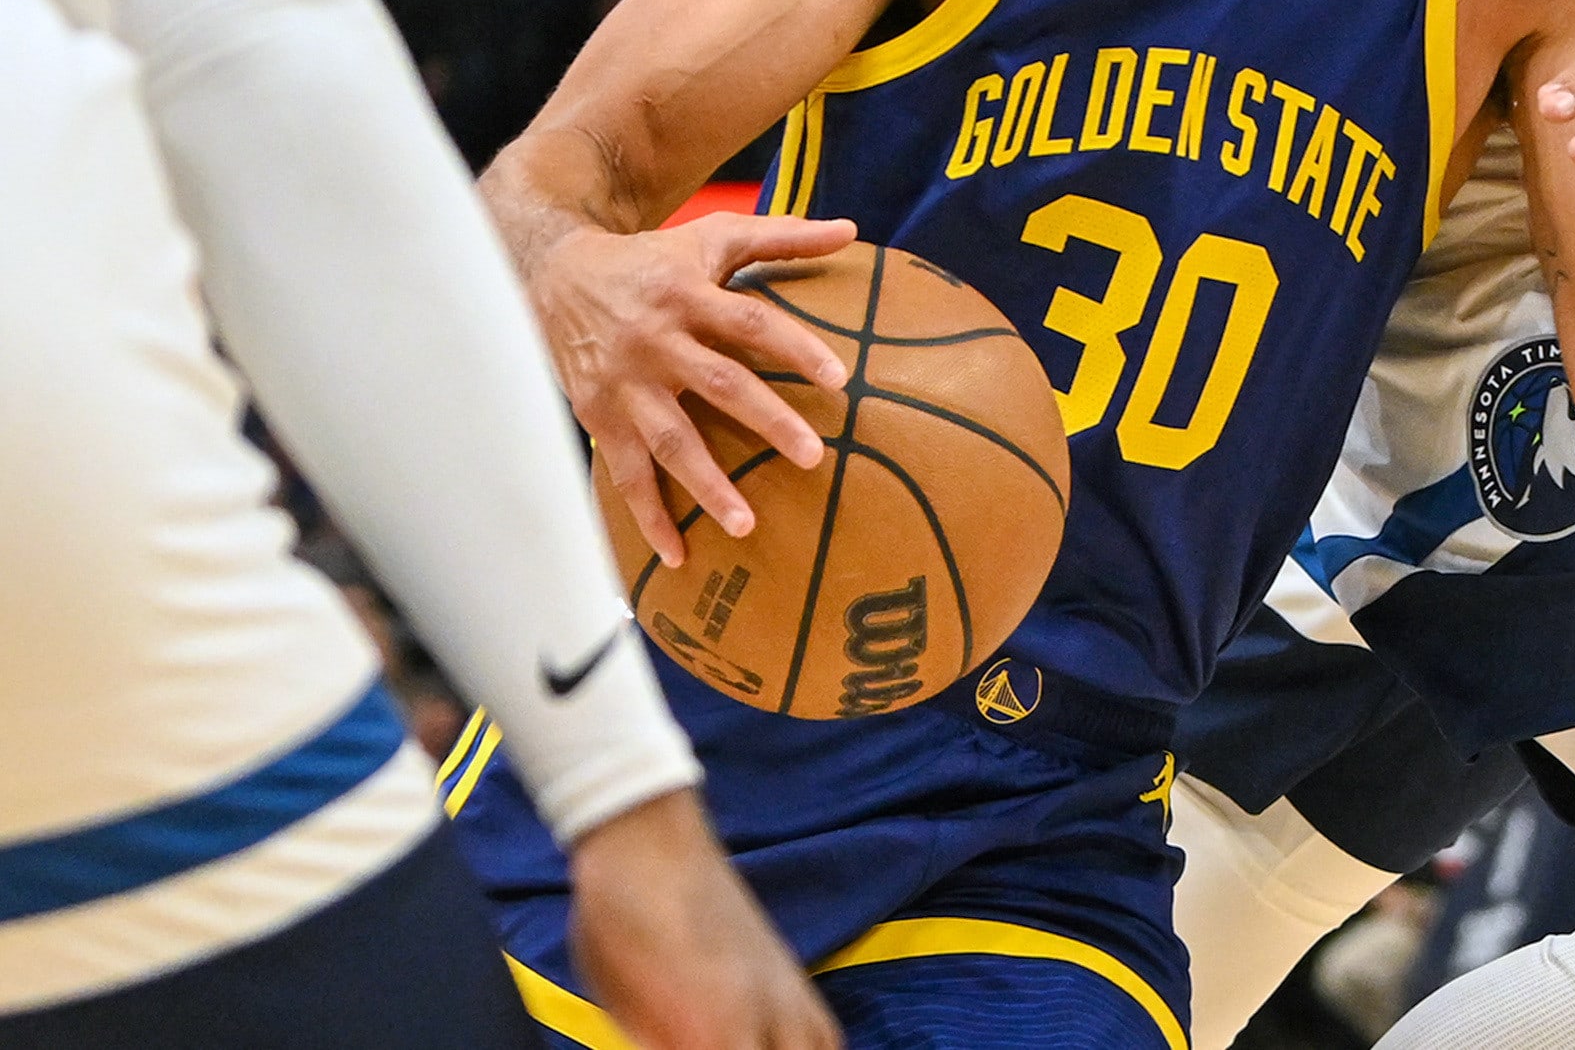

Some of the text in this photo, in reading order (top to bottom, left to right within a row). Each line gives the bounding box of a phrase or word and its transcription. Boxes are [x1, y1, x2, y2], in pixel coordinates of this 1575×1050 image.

[944, 46, 1397, 263] GOLDEN STATE
[1020, 193, 1280, 471] 30
[1474, 365, 1514, 509] MINNESOTA
